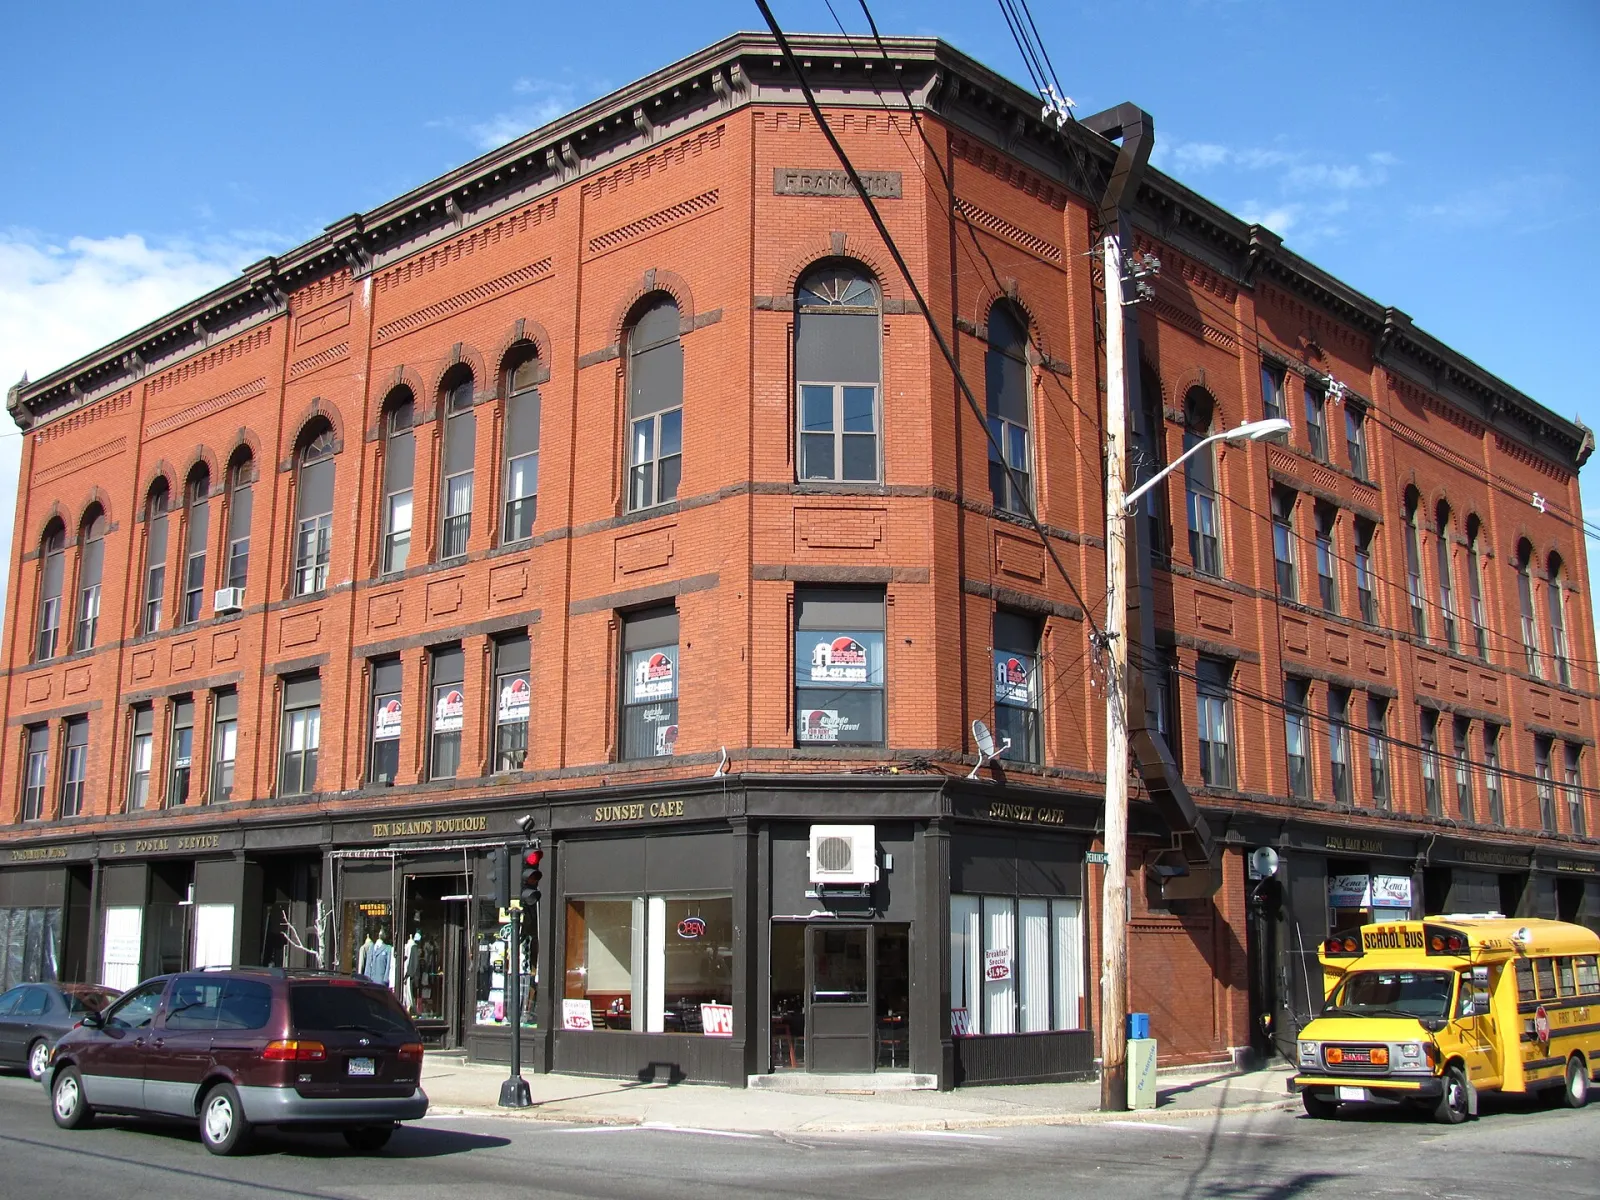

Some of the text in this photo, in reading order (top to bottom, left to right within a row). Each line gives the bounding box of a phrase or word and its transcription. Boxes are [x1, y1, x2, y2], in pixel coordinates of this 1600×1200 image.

[595, 800, 684, 822] SUNSET CAFE
[989, 802, 1065, 824] SUNSET CAFE
[372, 816, 486, 837] TEN ISLANDS BOUTIQUE
[136, 838, 169, 852] POSTAL
[178, 835, 220, 849] SERVICE
[1086, 852, 1104, 863] PERKINS
[1383, 876, 1408, 891] Lena's
[677, 921, 704, 936] OPEN
[1364, 931, 1424, 949] SCHOOL BUS
[985, 949, 1009, 959] Breakfast
[989, 957, 1006, 966] Special
